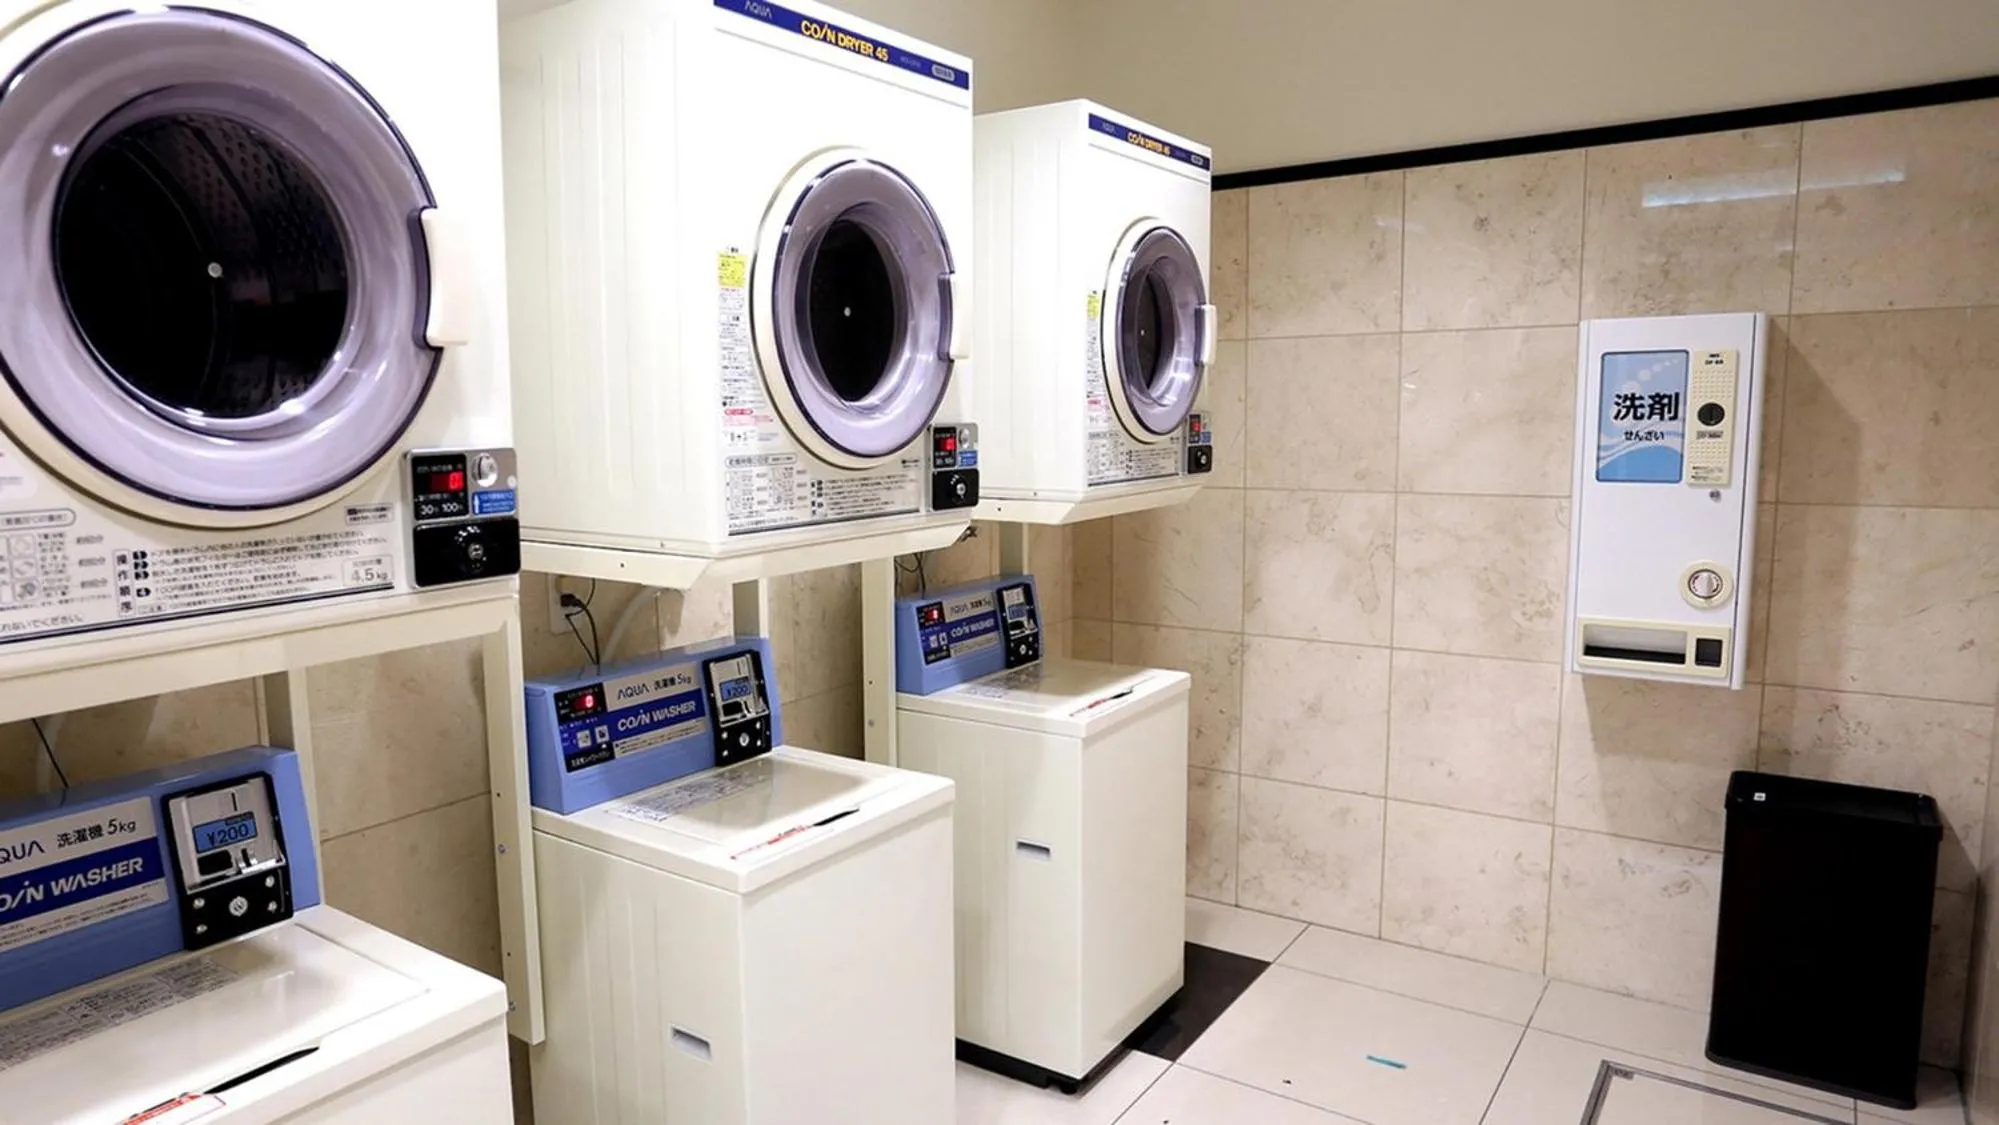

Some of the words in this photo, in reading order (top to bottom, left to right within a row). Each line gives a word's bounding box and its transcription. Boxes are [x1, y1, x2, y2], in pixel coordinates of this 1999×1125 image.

[837, 32, 874, 57] DRYER
[875, 46, 889, 61] 45
[1614, 392, 1680, 421] 洗剤
[1624, 430, 1664, 441] せんざい
[618, 683, 650, 700] AQUA
[652, 700, 697, 722] WASHER
[57, 824, 103, 848] 洗濯機
[107, 818, 136, 836] 5kg
[206, 823, 249, 847] ¥200
[50, 856, 144, 896] WASHER
